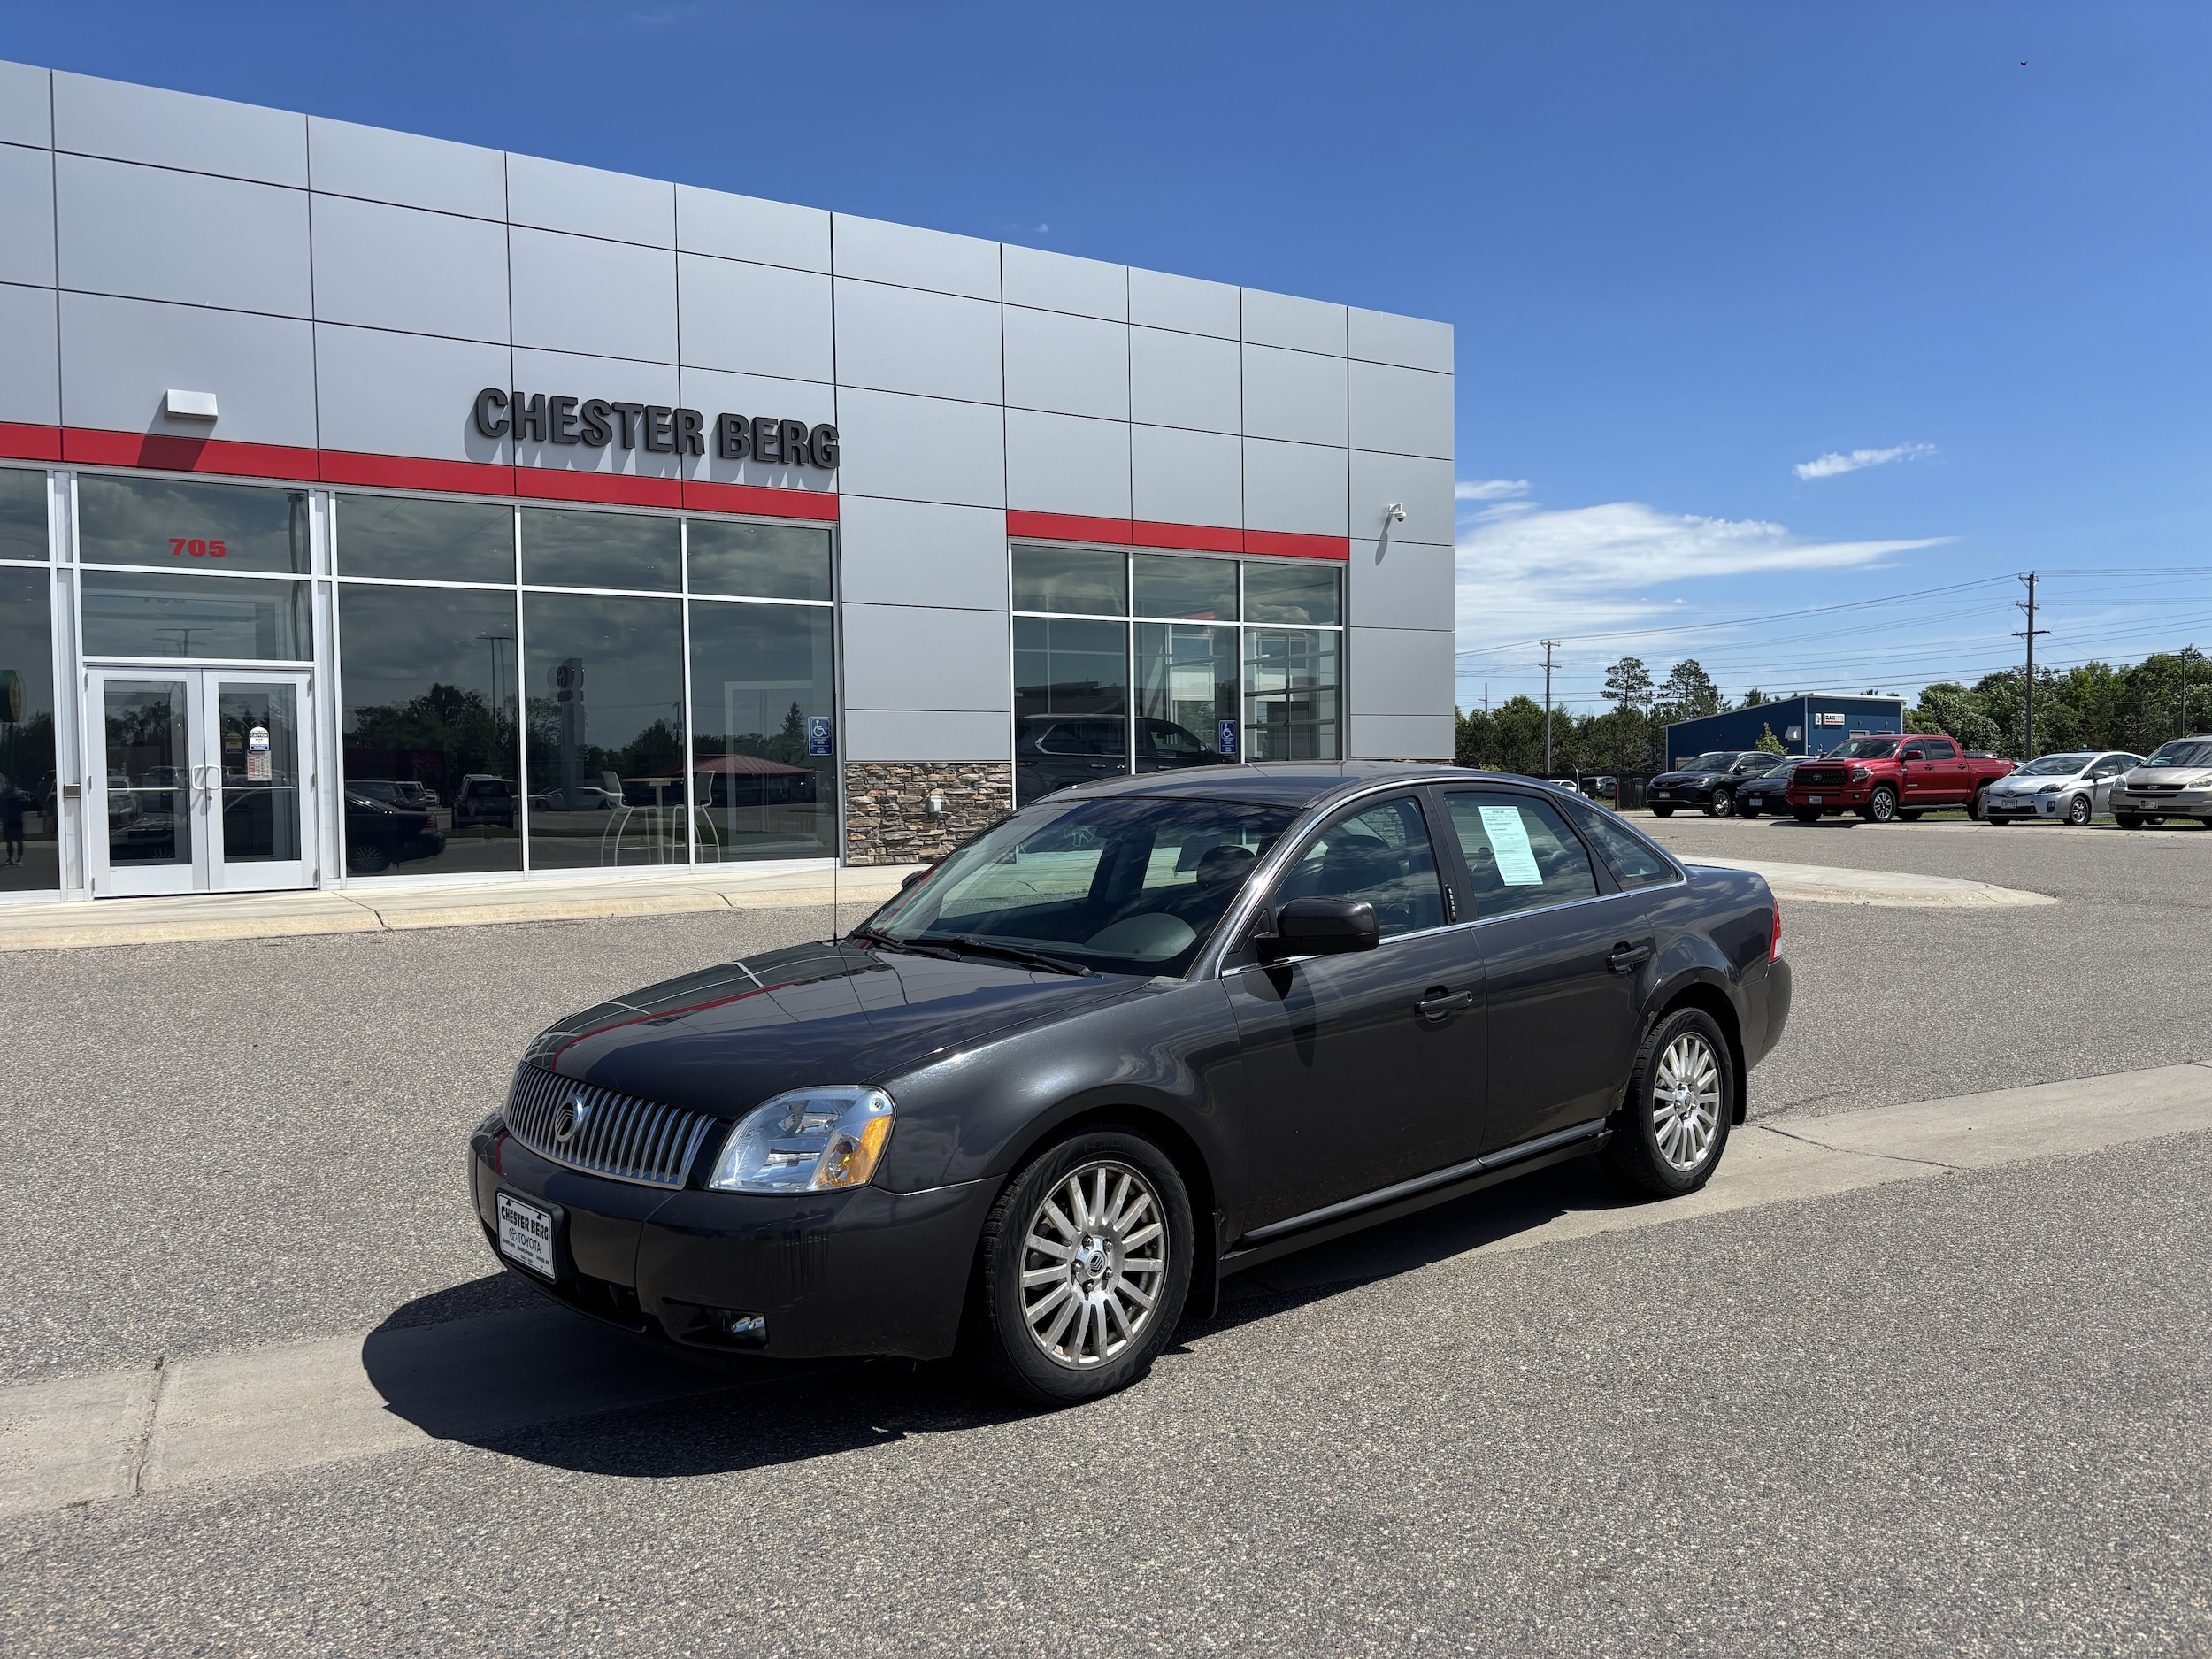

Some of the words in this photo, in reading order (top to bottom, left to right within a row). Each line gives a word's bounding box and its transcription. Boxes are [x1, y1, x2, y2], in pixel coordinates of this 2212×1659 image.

[475, 388, 705, 455] CHESTER
[718, 412, 840, 469] BERG
[169, 538, 227, 557] 705
[502, 1206, 529, 1232] CHESTER
[531, 1219, 549, 1241] BERG
[517, 1231, 541, 1254] TOYOTA
[1145, 1291, 1182, 1358] SOLSTICE
